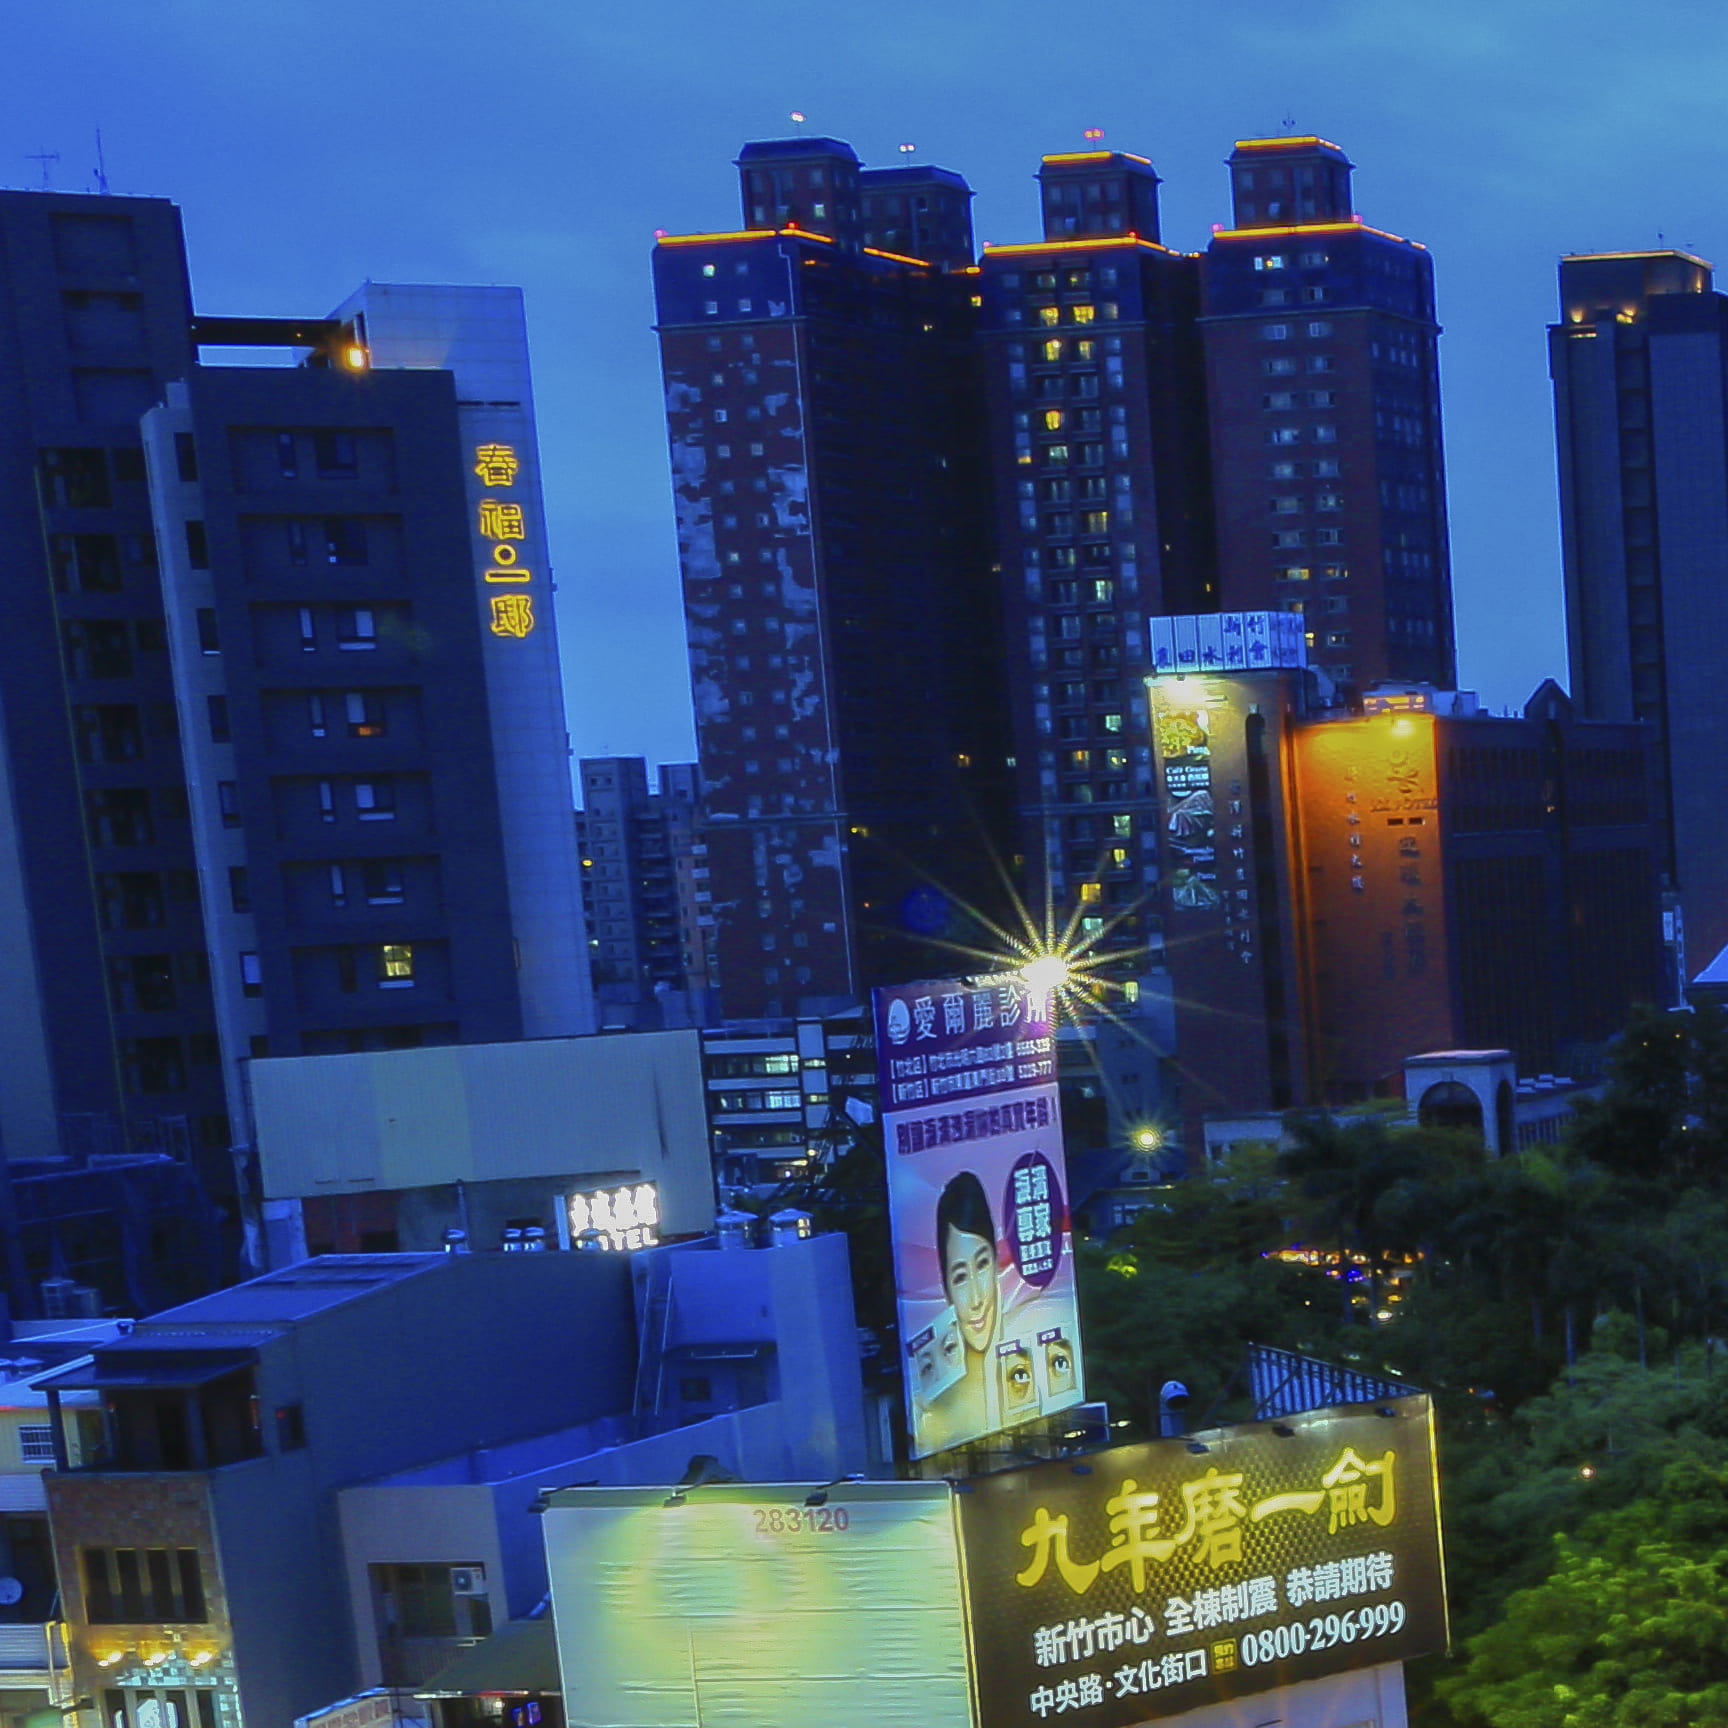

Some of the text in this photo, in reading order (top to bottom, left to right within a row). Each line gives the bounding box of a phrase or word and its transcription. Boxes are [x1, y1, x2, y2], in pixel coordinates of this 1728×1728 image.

[754, 1507, 850, 1535] 283120
[1033, 1606, 1155, 1668] 新竹市心
[1164, 1577, 1277, 1638] 全棟制震
[1286, 1552, 1395, 1603] 恭請期待
